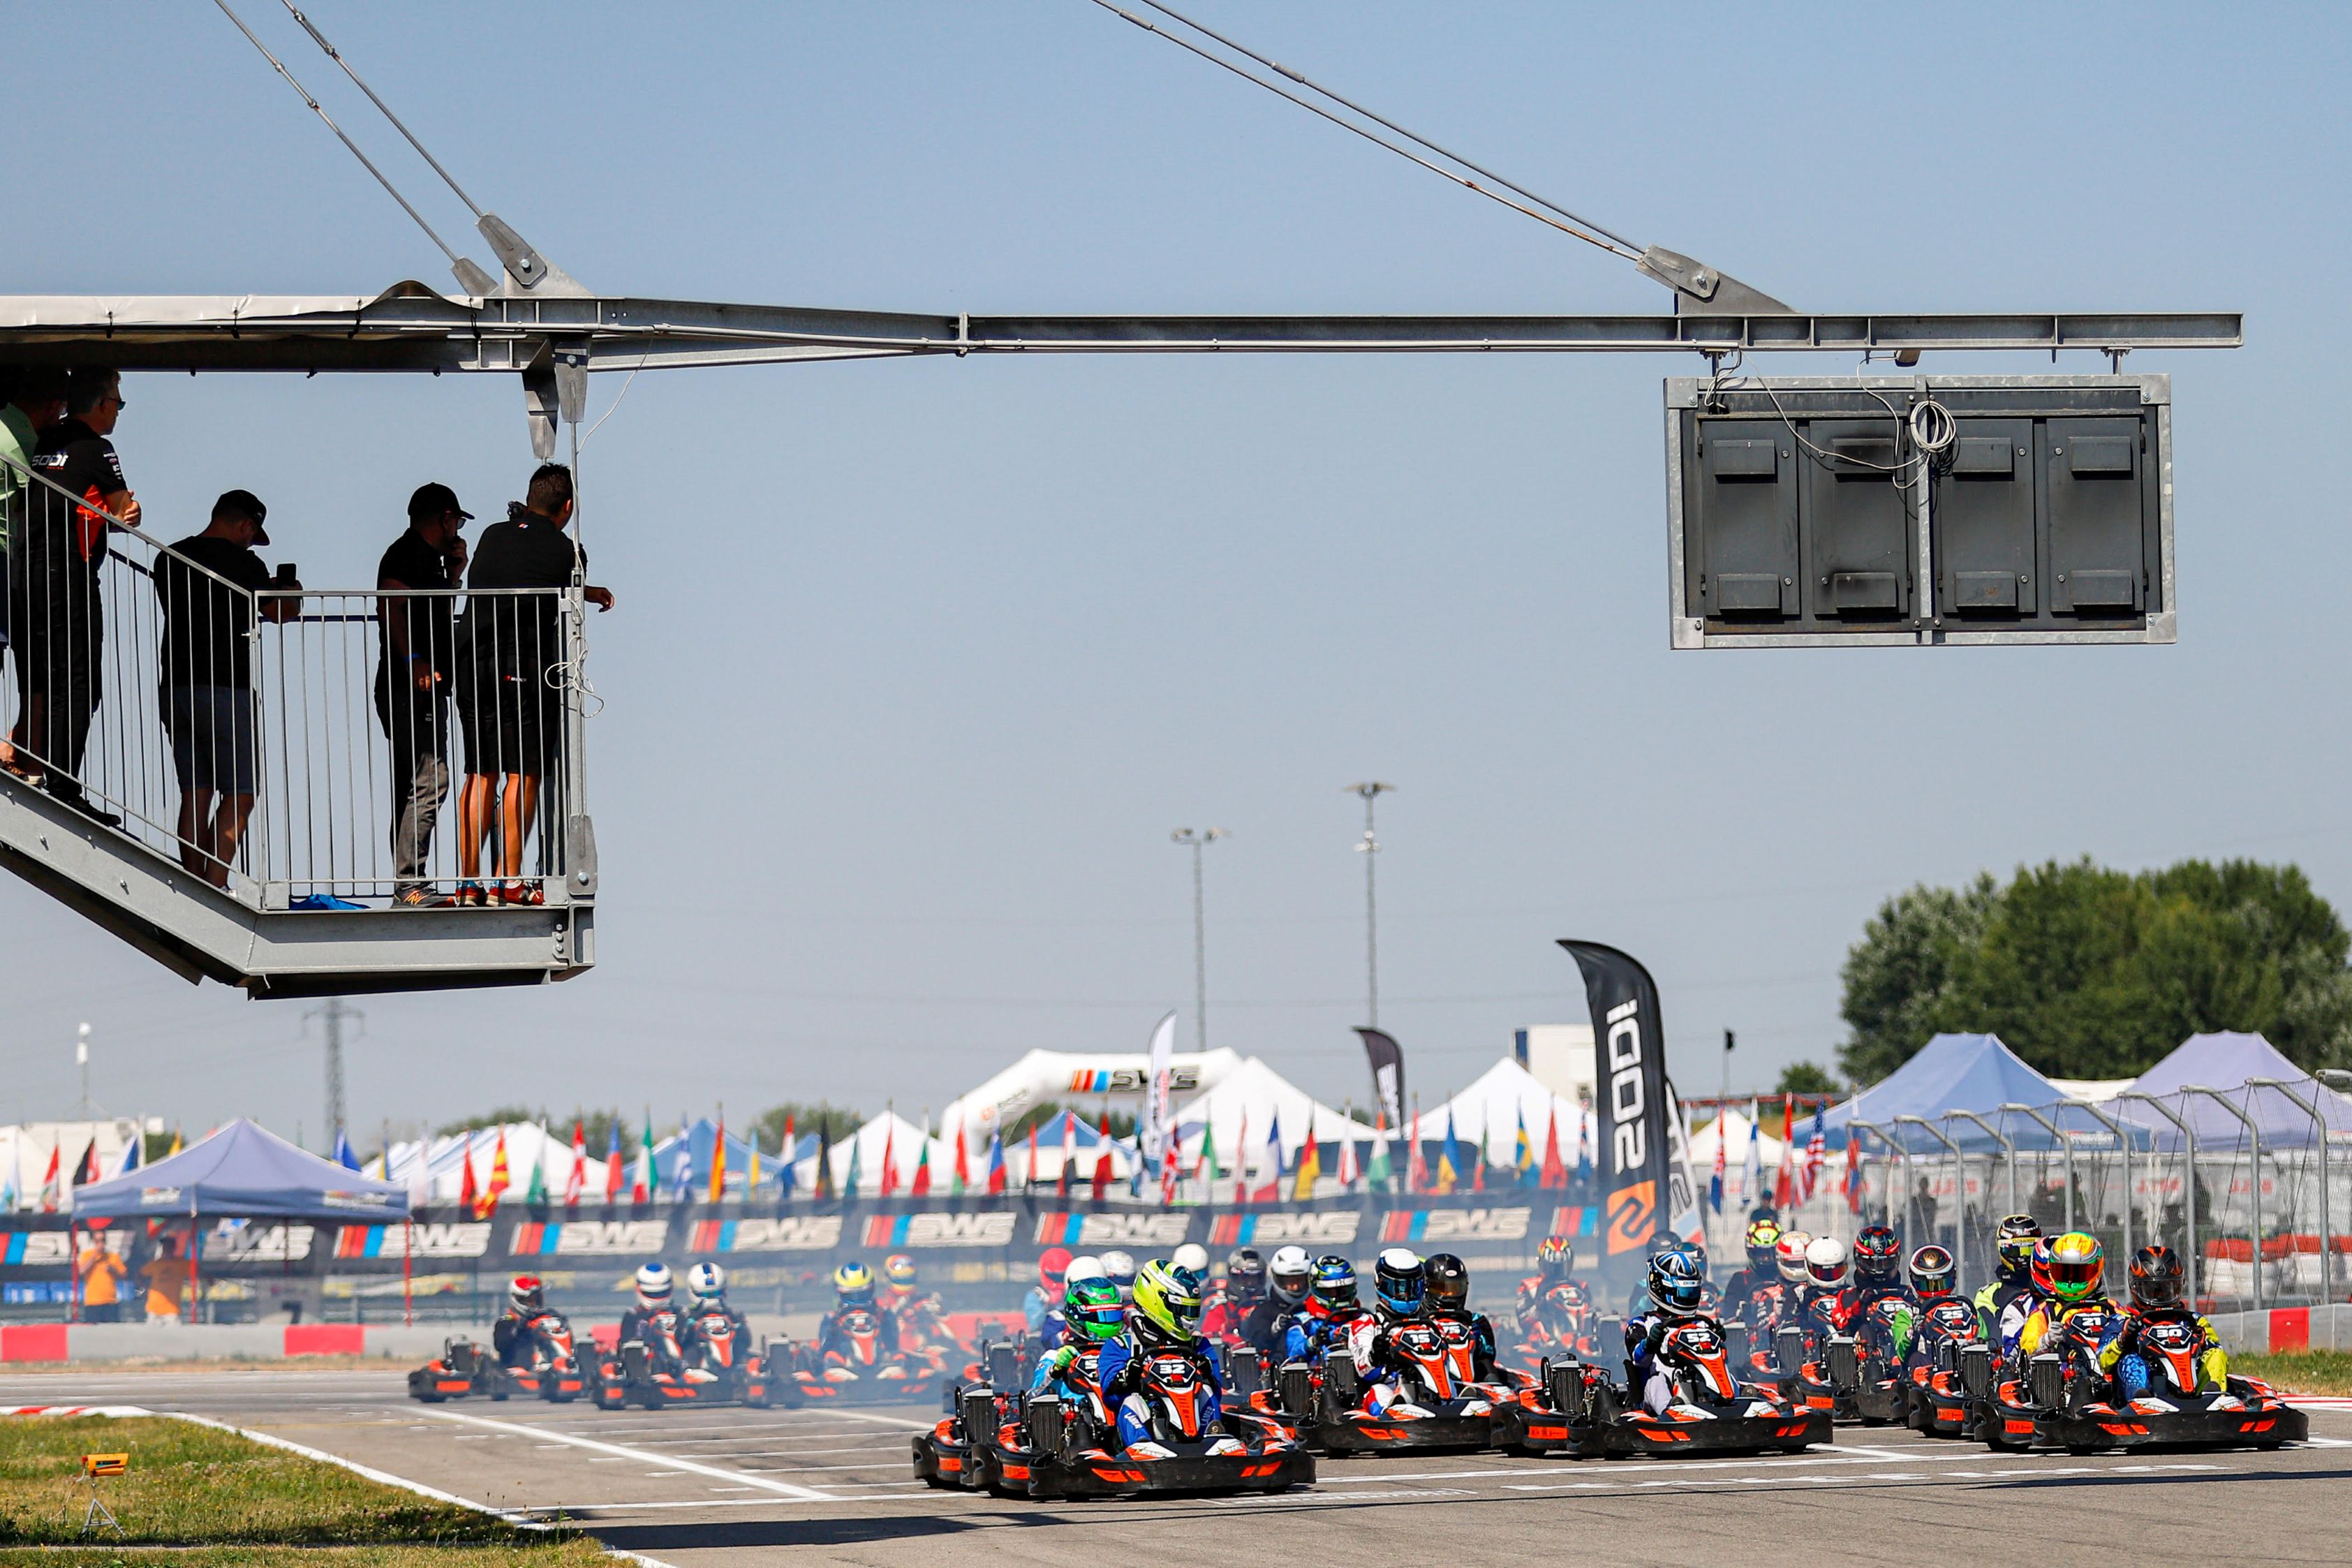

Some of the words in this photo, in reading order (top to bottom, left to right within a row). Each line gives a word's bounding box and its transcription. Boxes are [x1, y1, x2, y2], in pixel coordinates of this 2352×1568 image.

[31, 454, 68, 466] SODI
[1110, 1066, 1200, 1092] SS
[1606, 998, 1646, 1175] SODI
[558, 1220, 669, 1256] SWS
[733, 1215, 843, 1252] SWS
[906, 1211, 1017, 1247] SWS
[1079, 1213, 1191, 1247] SWS
[1256, 1211, 1361, 1245] SWS
[1423, 1206, 1532, 1241] SWS
[380, 1222, 491, 1258] SWS
[1941, 1310, 1963, 1319] 25
[2083, 1317, 2101, 1326] 21
[1410, 1333, 1431, 1344] 15
[1687, 1333, 1711, 1343] 52
[2157, 1329, 2183, 1338] 30
[1160, 1364, 1185, 1374] 32
